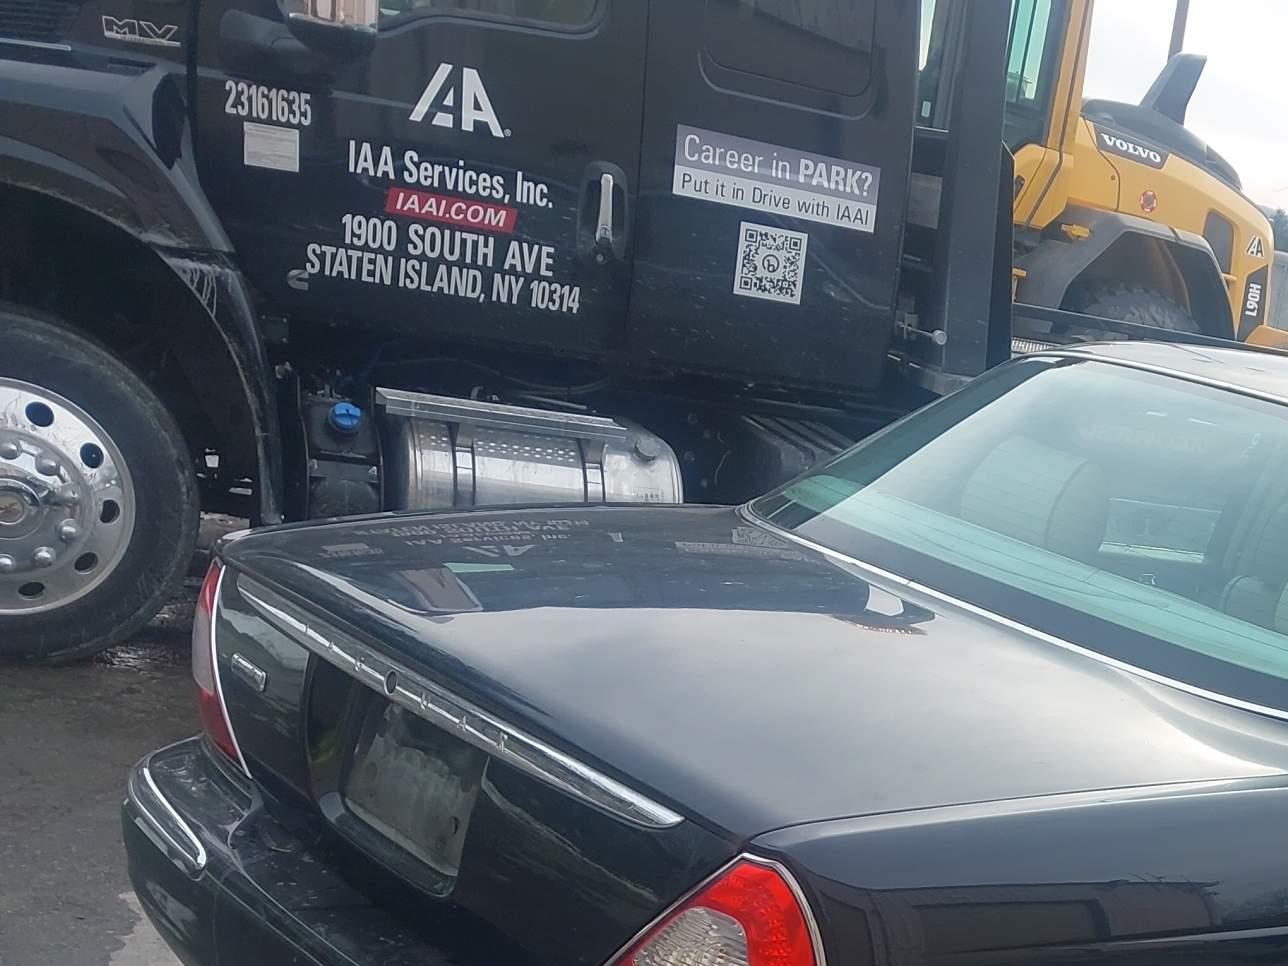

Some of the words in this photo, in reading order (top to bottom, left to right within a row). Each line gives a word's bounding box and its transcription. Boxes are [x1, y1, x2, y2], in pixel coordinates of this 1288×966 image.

[225, 79, 312, 126] 23161635
[349, 140, 395, 180] IAA
[404, 150, 510, 203] Services,
[516, 171, 553, 208] Inc.
[684, 134, 764, 173] Career
[771, 153, 790, 180] in
[799, 158, 873, 196] PARK?
[1101, 133, 1161, 163] VOLVO
[396, 192, 507, 228] IAAI.COM
[682, 173, 709, 194] Put
[715, 178, 726, 197] it
[732, 182, 744, 200] in
[752, 187, 790, 210] Drive
[798, 198, 830, 218] with
[836, 204, 869, 226] IAAI
[342, 213, 397, 250] 1900
[408, 223, 494, 267] SOUTH
[504, 240, 555, 276] AVE
[306, 243, 393, 285] STATEN
[399, 257, 485, 302] ISLAND,
[492, 273, 524, 304] NY
[531, 279, 580, 313] 10314
[1245, 283, 1262, 317] L90H
